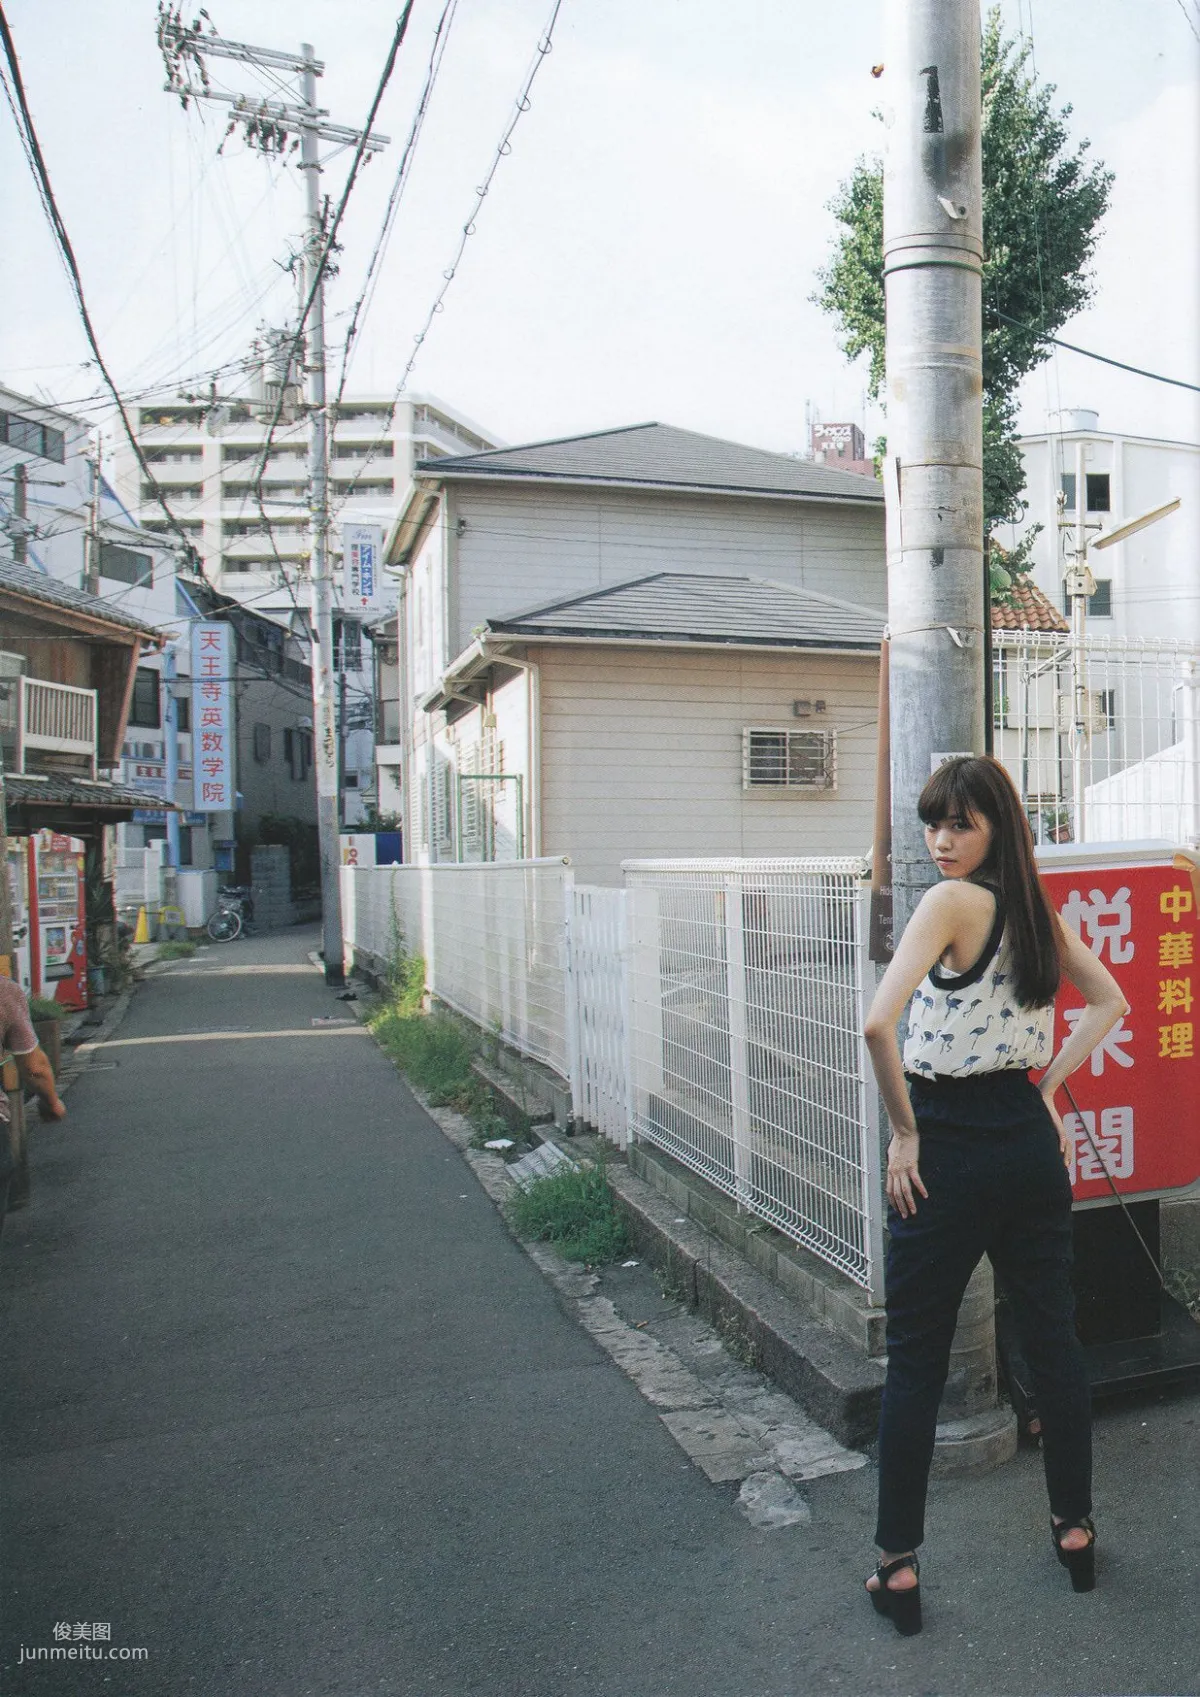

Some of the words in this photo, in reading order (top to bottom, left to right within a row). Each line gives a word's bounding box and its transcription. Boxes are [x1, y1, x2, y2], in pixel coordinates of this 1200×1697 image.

[200, 630, 225, 803] 天王寺英数学院
[1158, 884, 1195, 1059] 中華料理
